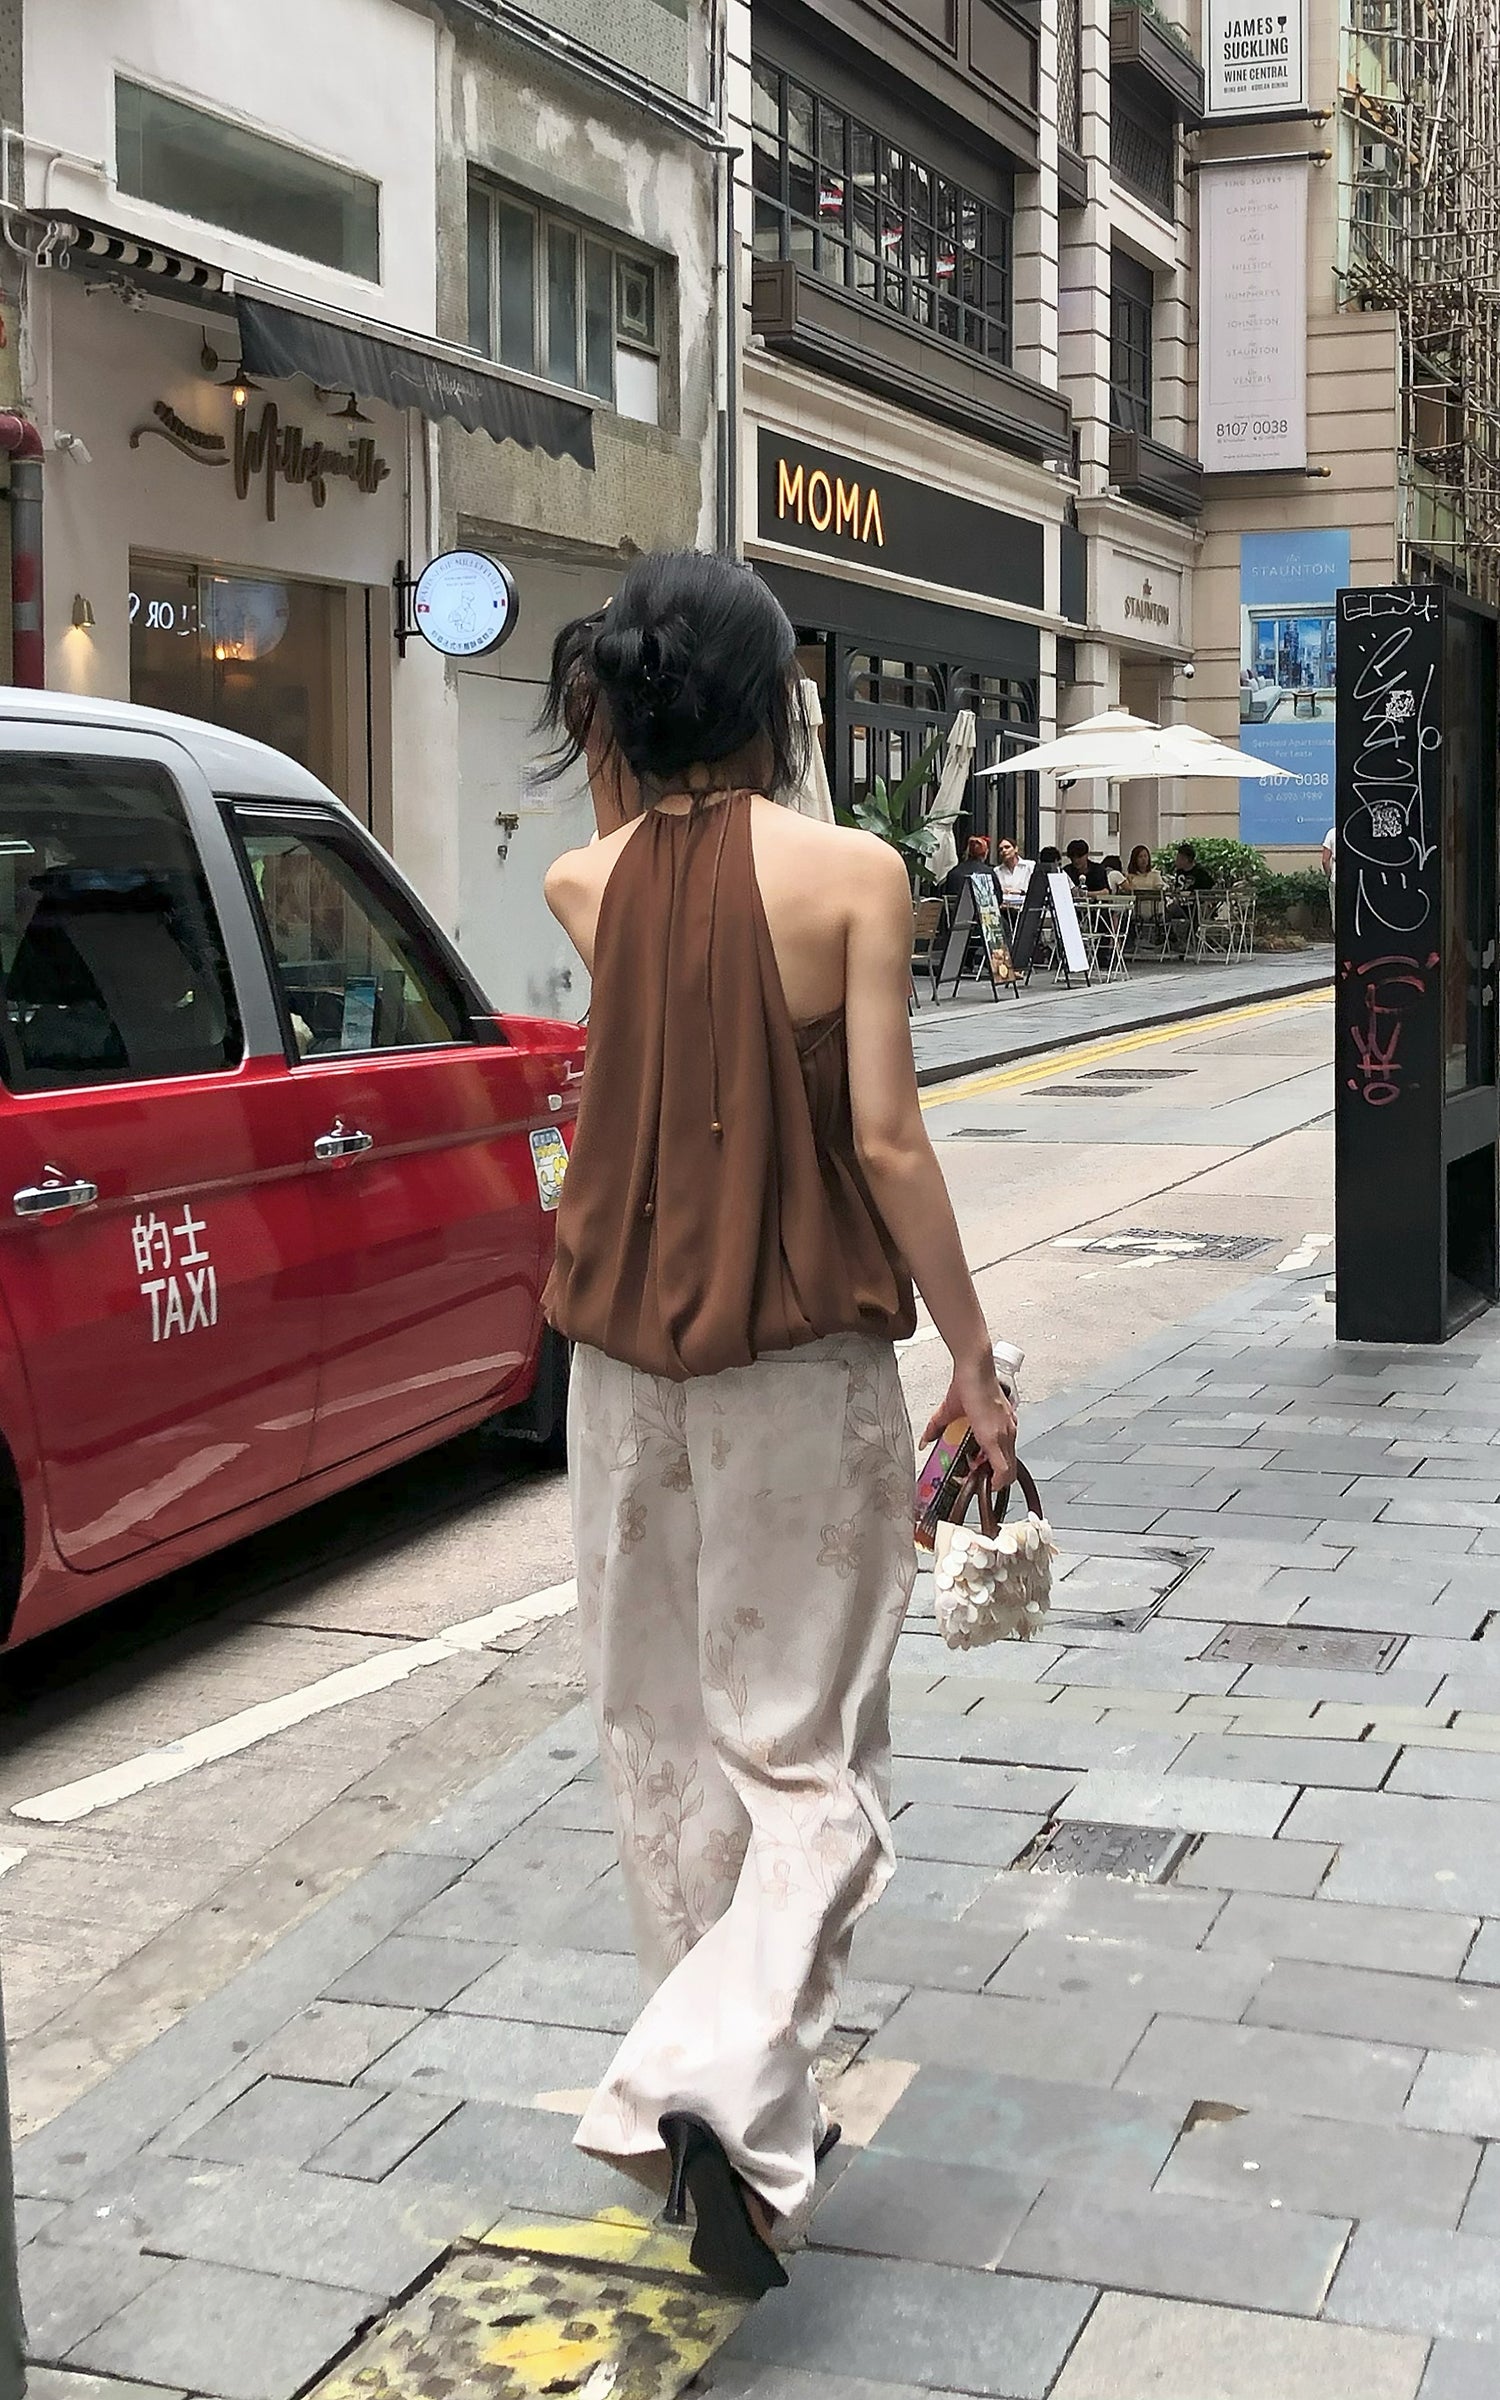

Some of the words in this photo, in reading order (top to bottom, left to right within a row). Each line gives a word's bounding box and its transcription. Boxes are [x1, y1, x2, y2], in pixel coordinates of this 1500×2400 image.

[1224, 16, 1273, 39] JAMES
[1223, 37, 1289, 60] SUCKLING
[1224, 68, 1247, 83] WINE
[1249, 65, 1288, 81] CENTRAL
[1225, 346, 1279, 357] STAUNTON
[1216, 422, 1248, 437] 8107
[1253, 419, 1288, 435] 0038
[778, 458, 885, 547] MOMA
[1251, 563, 1336, 577] STAUNTON
[1124, 596, 1170, 626] STAUNTON
[1258, 775, 1290, 787] 8107
[1295, 773, 1329, 786] 0038
[132, 1203, 210, 1275] 的士
[141, 1266, 219, 1343] TAXI
